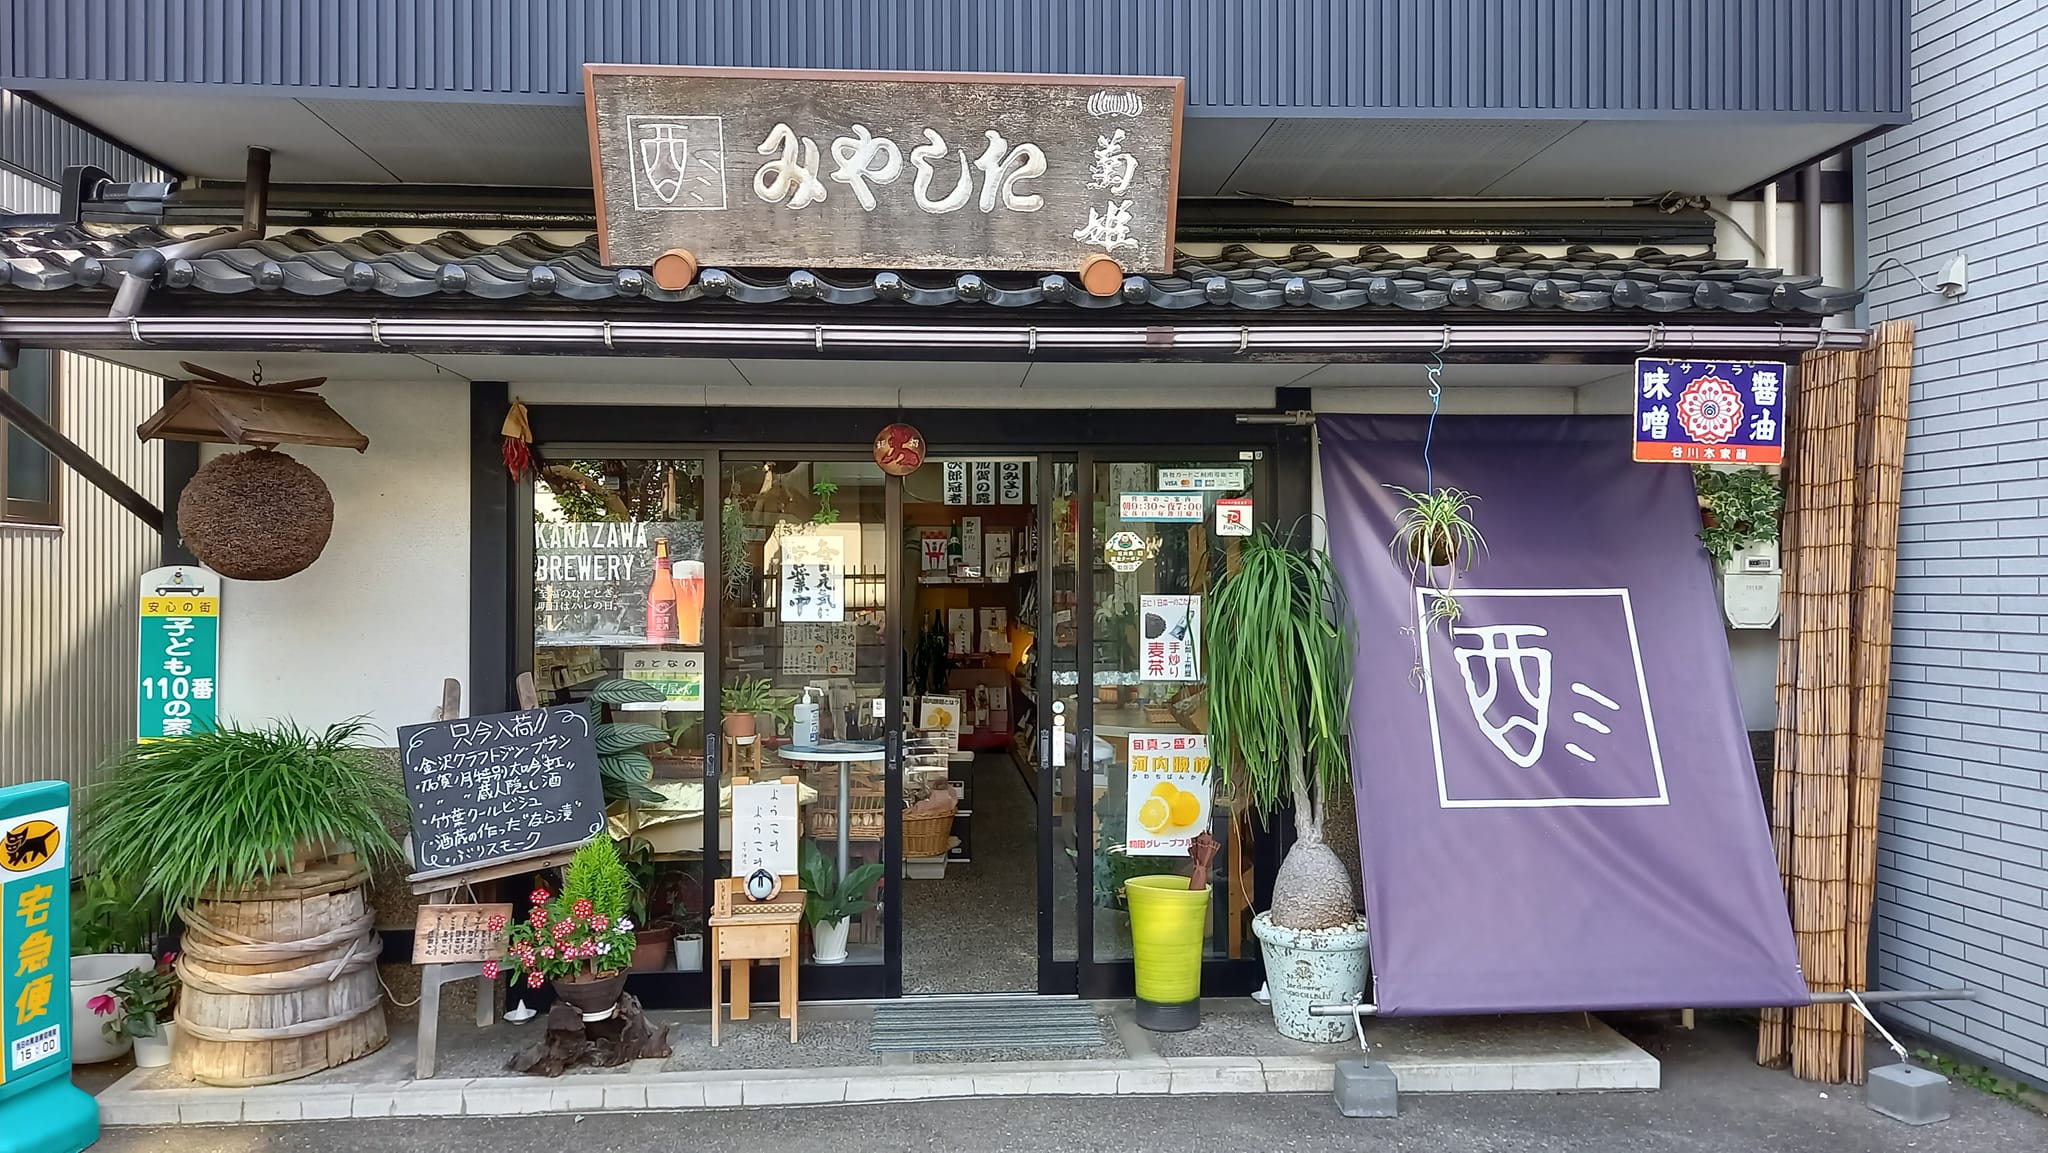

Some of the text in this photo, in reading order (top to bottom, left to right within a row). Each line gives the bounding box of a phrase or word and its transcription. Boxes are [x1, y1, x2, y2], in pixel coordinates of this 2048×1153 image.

[753, 122, 1048, 214] みやした
[1680, 363, 1743, 375] サクラ
[1641, 366, 1672, 440] 味噌
[535, 522, 648, 549] KANAZAWA
[536, 554, 635, 581] BREWERY
[148, 602, 211, 613] 安心の街
[634, 659, 697, 669] おとなの
[1148, 642, 1165, 676] 麦茶
[15, 884, 54, 1025] 宅急便
